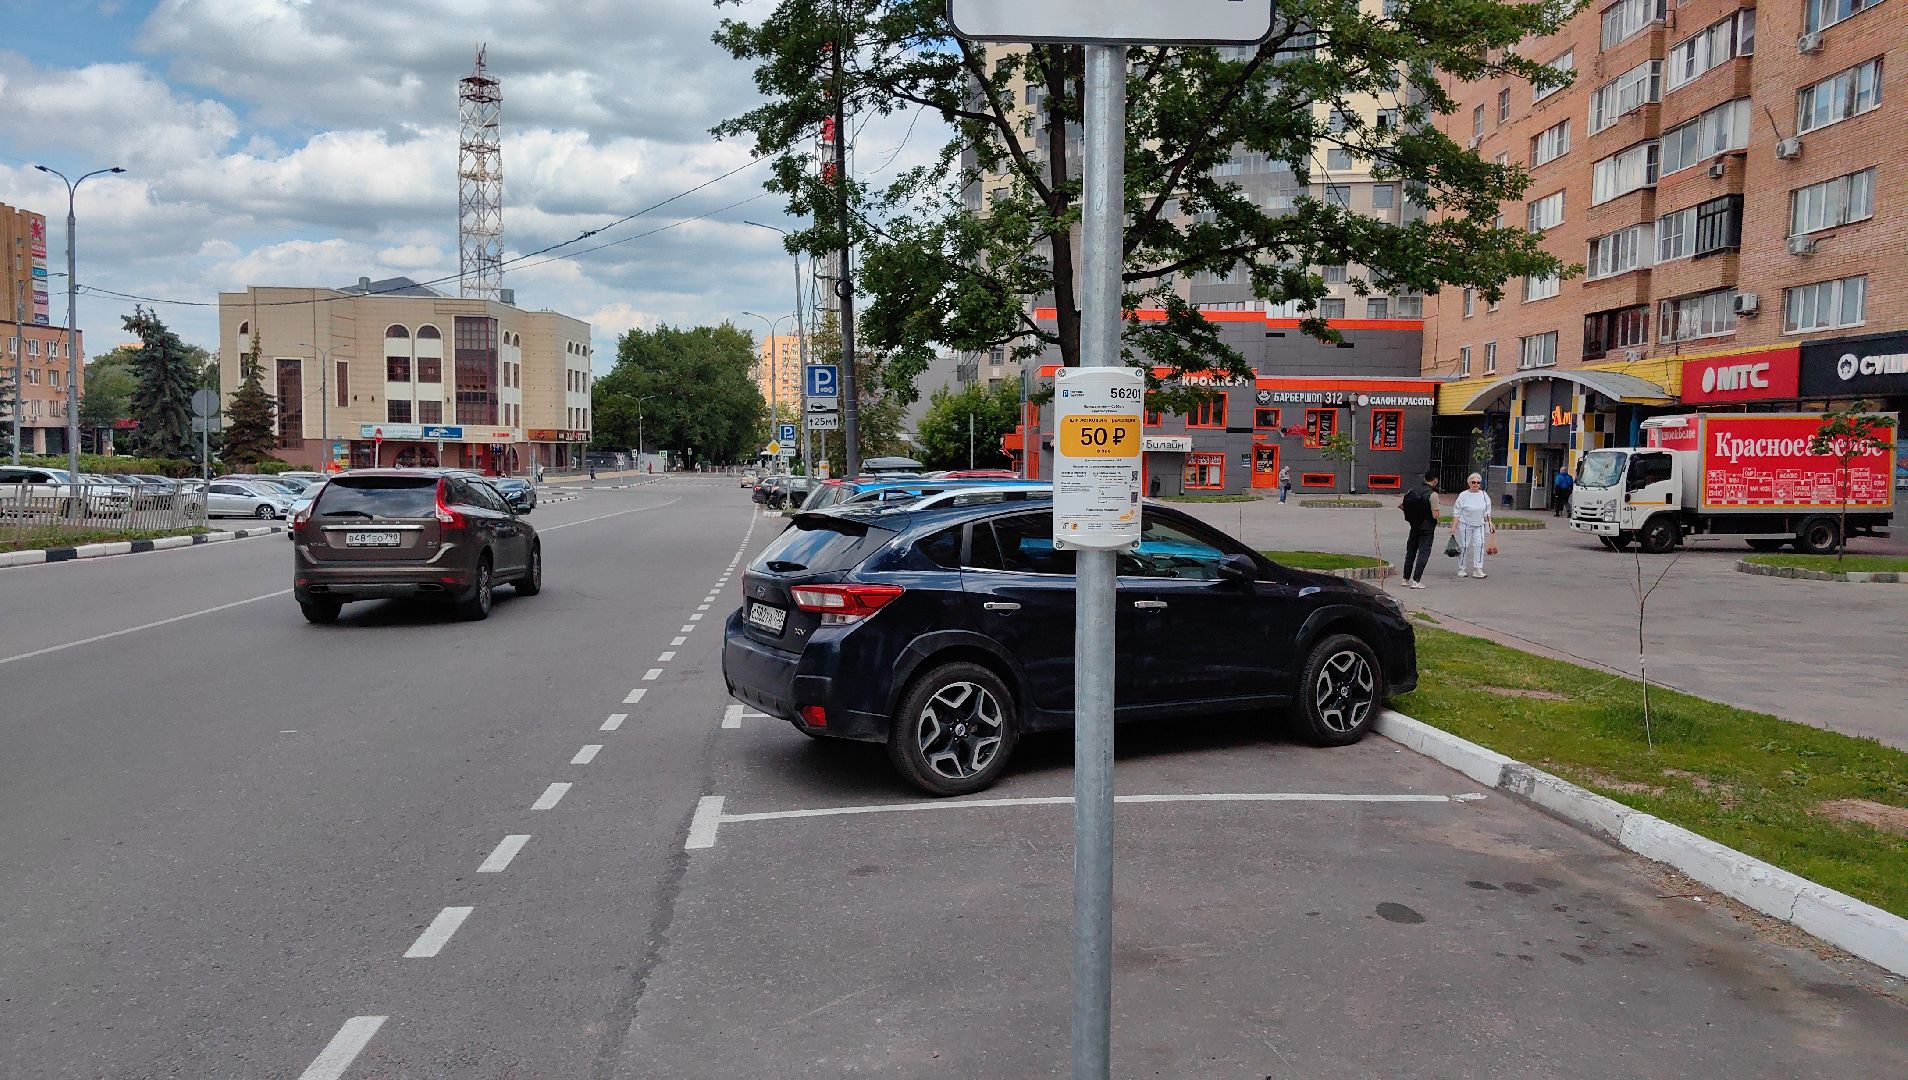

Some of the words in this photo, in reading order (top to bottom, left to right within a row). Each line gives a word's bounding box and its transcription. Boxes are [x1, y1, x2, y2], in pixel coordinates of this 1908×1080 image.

[1717, 362, 1770, 391] МТС
[1110, 387, 1141, 399] 56201
[1273, 392, 1323, 403] БАРБЕРШОП
[1324, 392, 1343, 404] 312
[1369, 396, 1397, 405] САЛОН
[1397, 397, 1435, 406] КРАСОТЫ
[1080, 427, 1108, 446] 50
[1112, 427, 1126, 446] ₽
